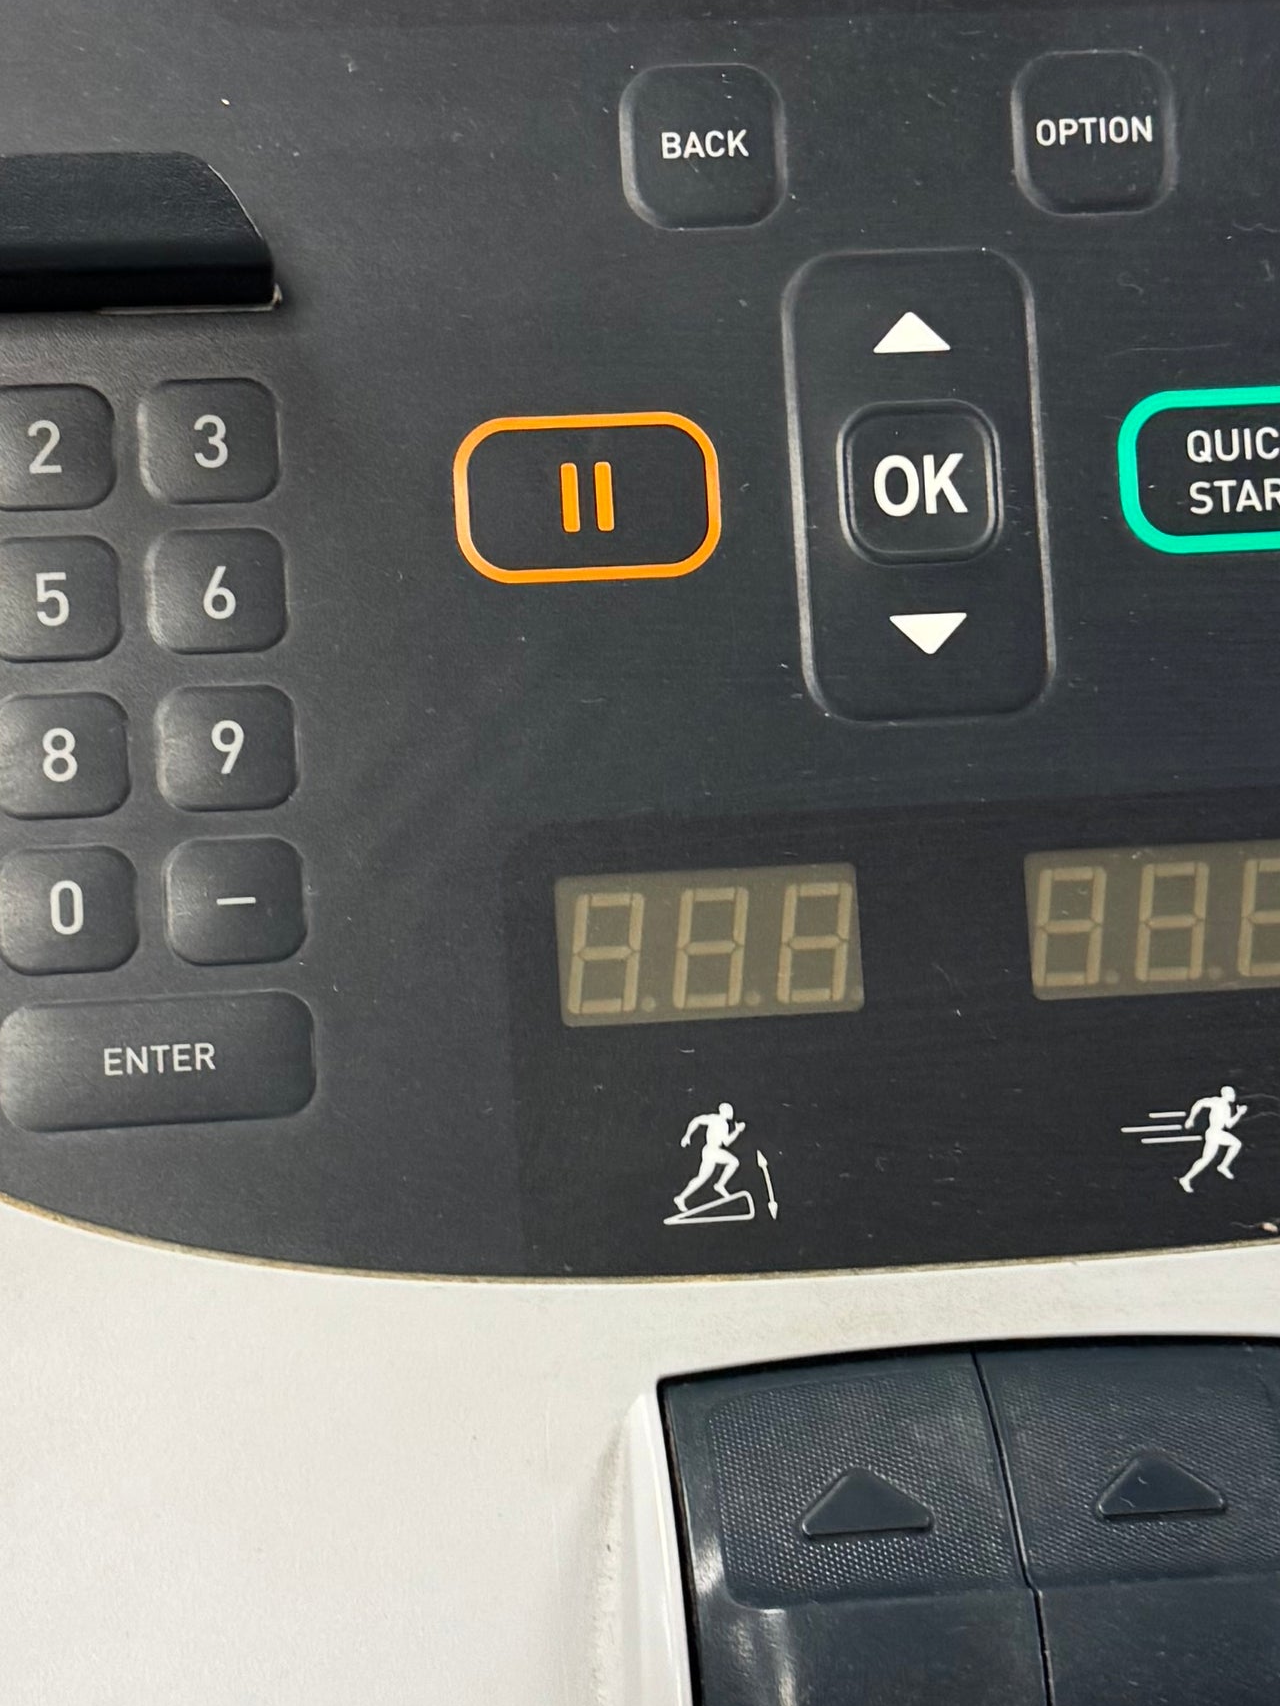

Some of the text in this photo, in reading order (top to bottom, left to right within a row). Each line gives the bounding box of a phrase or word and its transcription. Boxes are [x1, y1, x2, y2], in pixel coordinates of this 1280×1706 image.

[661, 129, 749, 159] BACK
[1036, 115, 1153, 146] OPTION
[27, 419, 62, 475] 2
[193, 414, 228, 469] 3
[873, 452, 968, 517] OK
[35, 571, 70, 627] 5
[203, 565, 236, 620] 6
[42, 727, 78, 783] 8
[211, 720, 245, 775] 9
[49, 880, 84, 935] 0
[103, 1042, 216, 1076] ENTER
